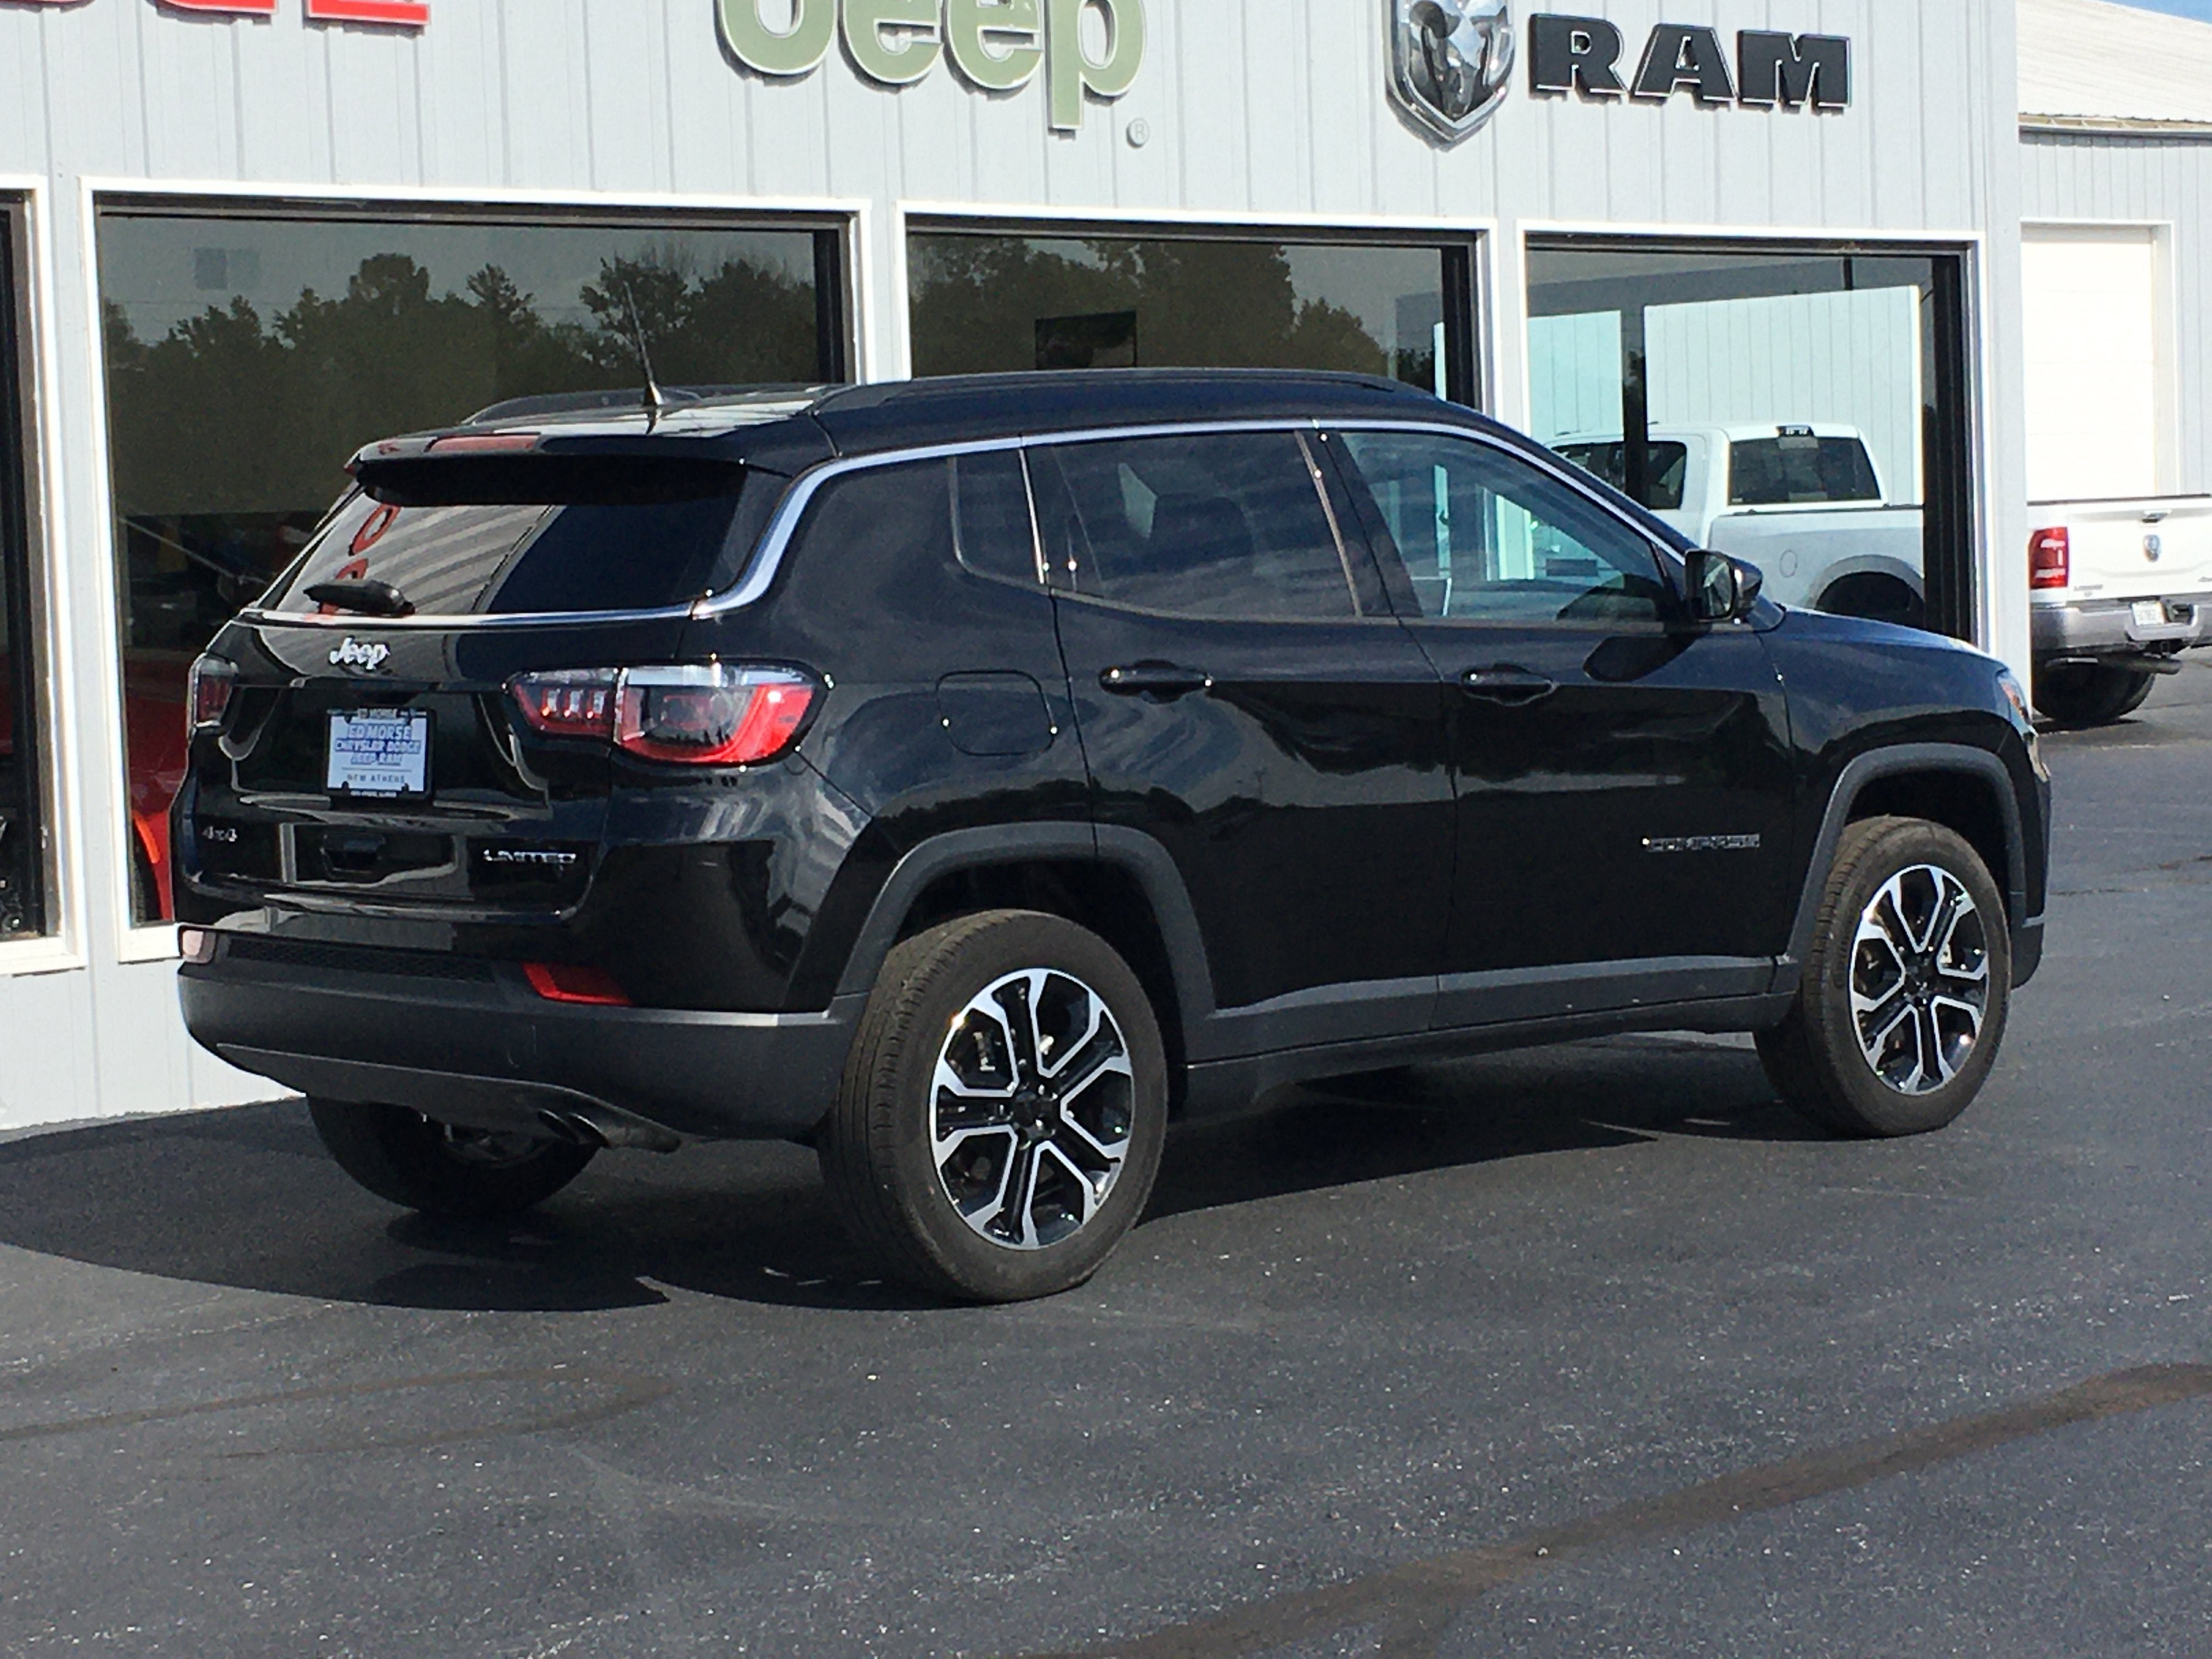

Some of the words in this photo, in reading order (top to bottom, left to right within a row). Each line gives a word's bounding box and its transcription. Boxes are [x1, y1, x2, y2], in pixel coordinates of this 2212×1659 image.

[1530, 14, 1851, 108] RAM
[330, 637, 391, 669] Jeep
[348, 725, 365, 738] ED
[368, 725, 411, 740] MORSE
[348, 774, 366, 782] NEW
[371, 775, 405, 783] ATHENS
[483, 849, 577, 864] LIMITED
